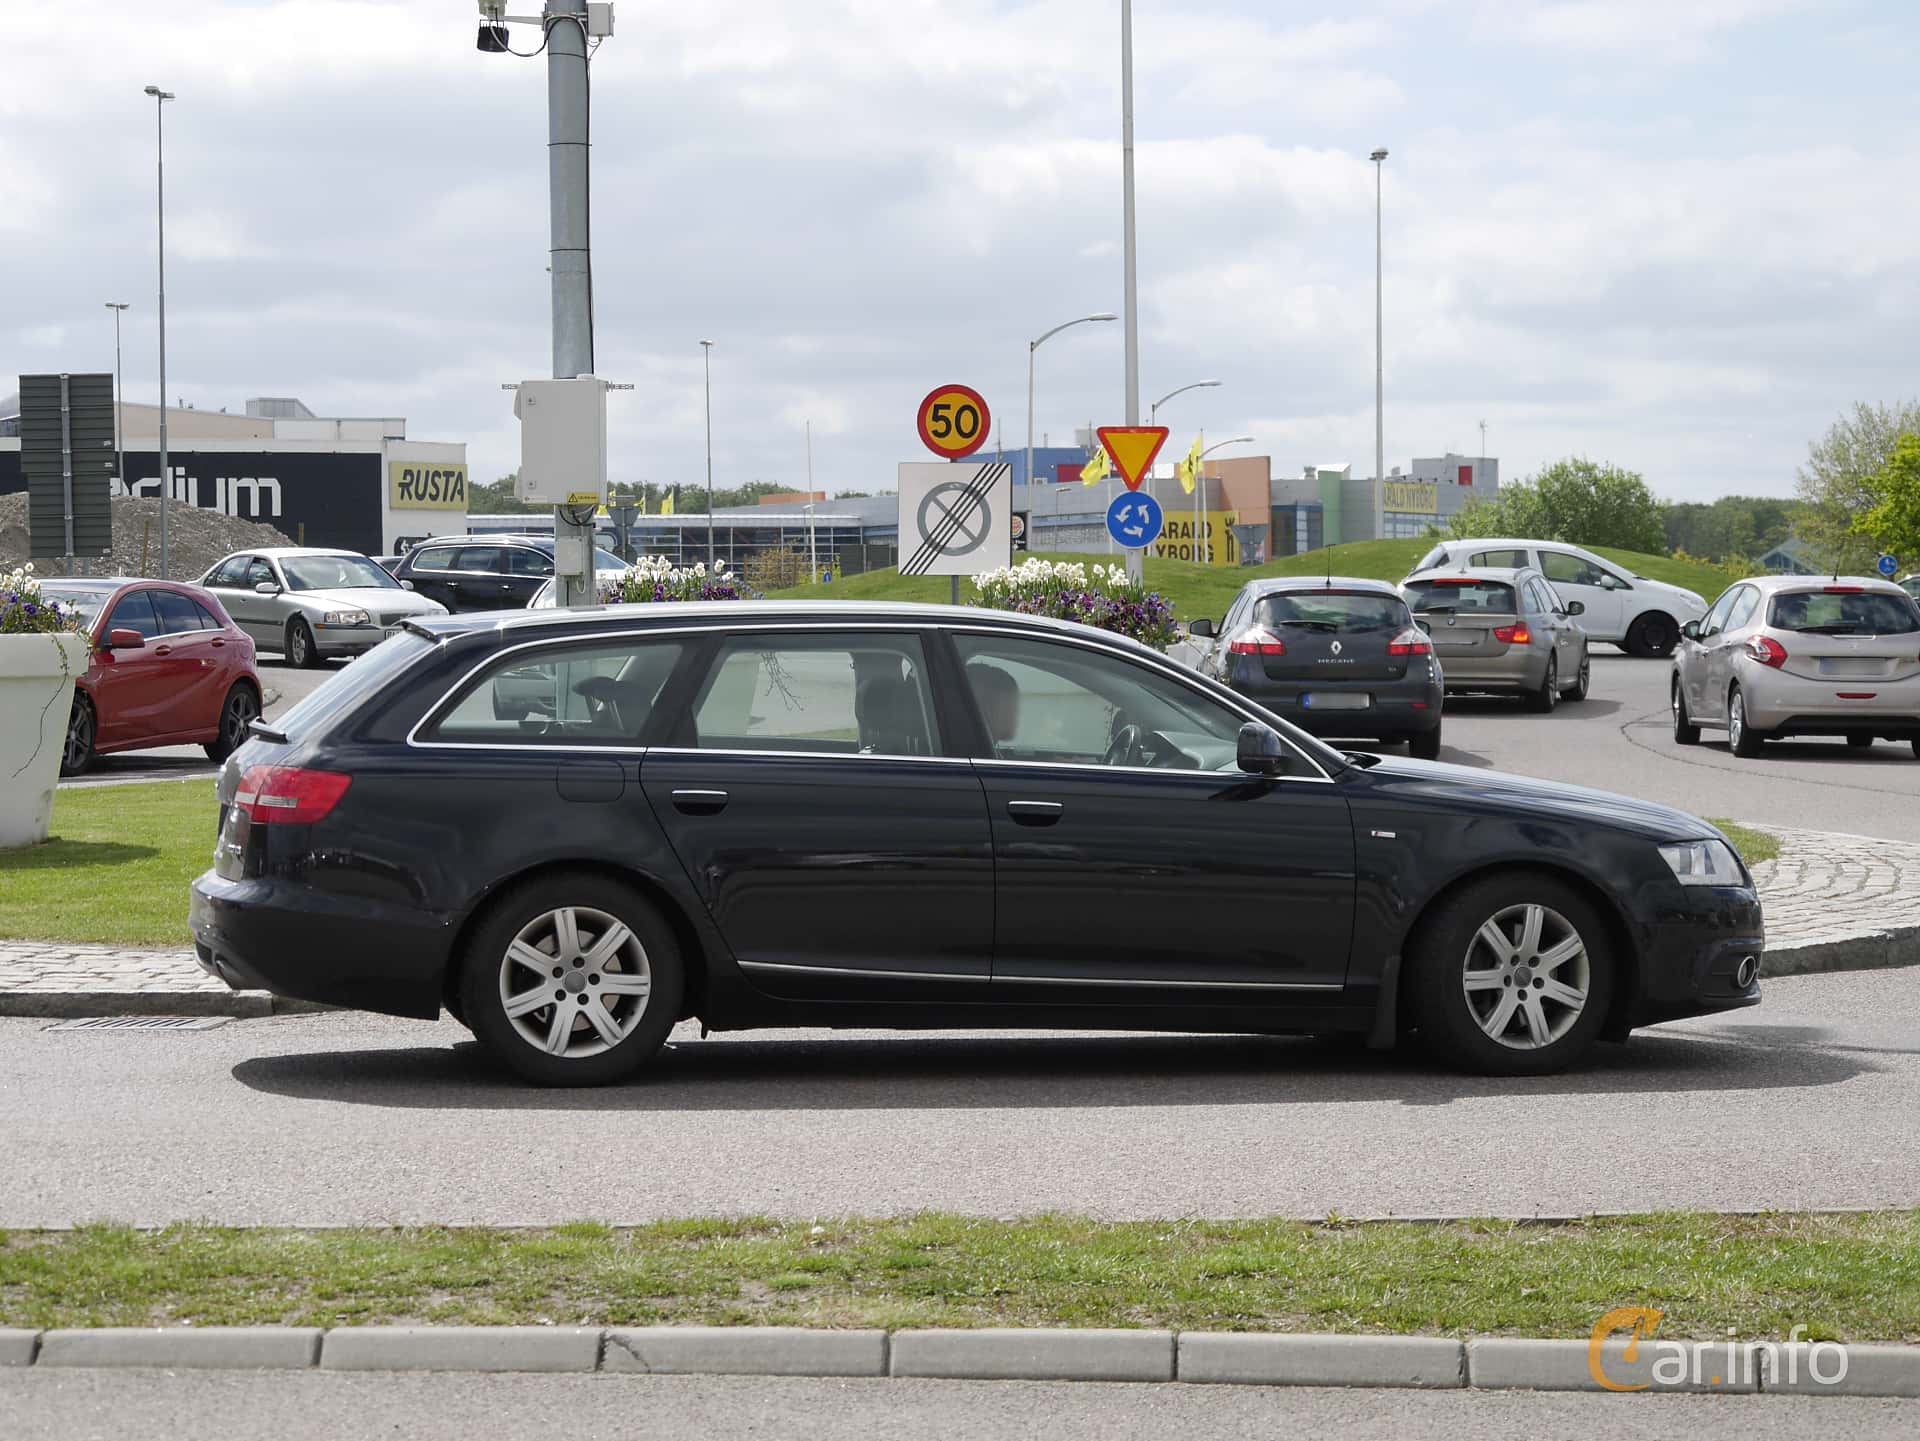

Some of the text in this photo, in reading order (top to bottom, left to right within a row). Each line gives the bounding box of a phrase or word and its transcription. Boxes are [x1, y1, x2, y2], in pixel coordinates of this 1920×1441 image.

[931, 404, 979, 438] 50
[398, 469, 464, 502] RUSTA
[1157, 521, 1213, 539] ARALD
[1144, 543, 1214, 562] YBORG
